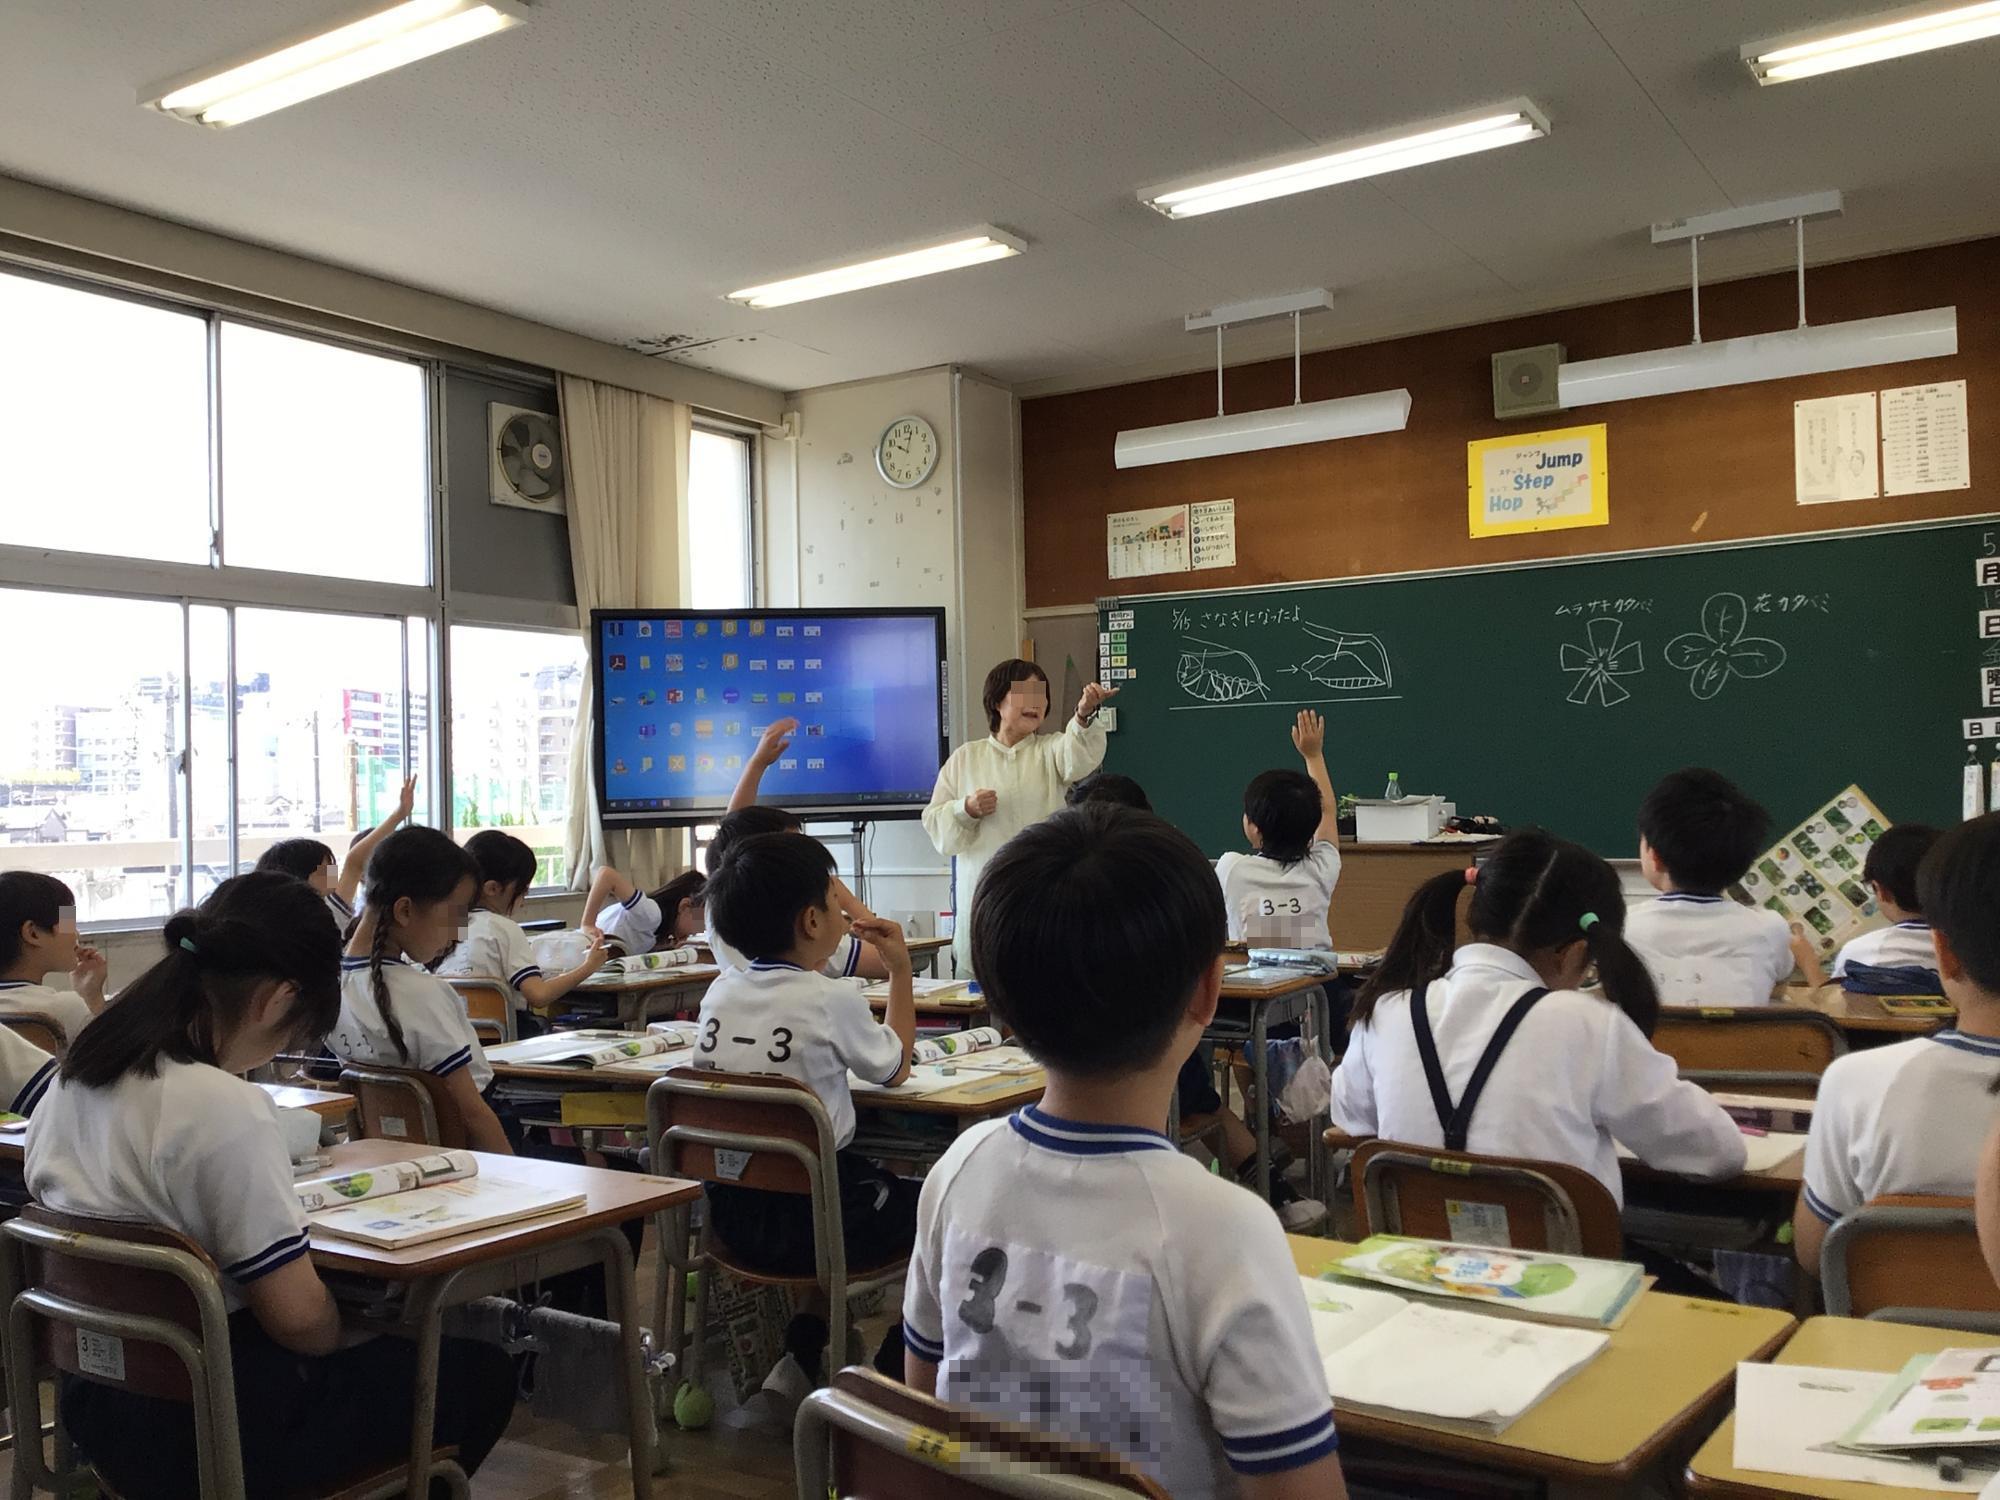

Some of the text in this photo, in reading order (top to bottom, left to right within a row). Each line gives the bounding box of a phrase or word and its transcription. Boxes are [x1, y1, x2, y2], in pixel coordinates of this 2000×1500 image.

[904, 424, 910, 433] 12
[915, 426, 918, 434] 1
[895, 429, 900, 438] 11
[921, 433, 926, 442] 2
[889, 439, 896, 447] 10
[925, 444, 930, 453] 3
[886, 451, 892, 460] 9
[923, 457, 927, 465] 4
[1536, 452, 1583, 470] Jump
[890, 463, 895, 471] 8
[916, 467, 921, 475] 5
[897, 470, 902, 478] 7
[905, 471, 911, 479] 6
[1513, 474, 1554, 491] Step
[1489, 495, 1523, 512] Hop
[1983, 532, 1996, 556] 5
[1982, 562, 2000, 584] 月
[1171, 604, 1301, 631] 5/15 さなぎになったよ
[1985, 615, 2000, 636] 日
[1102, 635, 1107, 643] 1
[1101, 646, 1108, 654] 2
[1102, 659, 1109, 668] 3
[1101, 670, 1108, 680] 4
[1263, 897, 1301, 915] 3-3
[700, 1017, 793, 1063] 3-3
[719, 1153, 724, 1165] 3
[958, 1247, 1099, 1360] 3-3
[81, 1336, 88, 1352] 3
